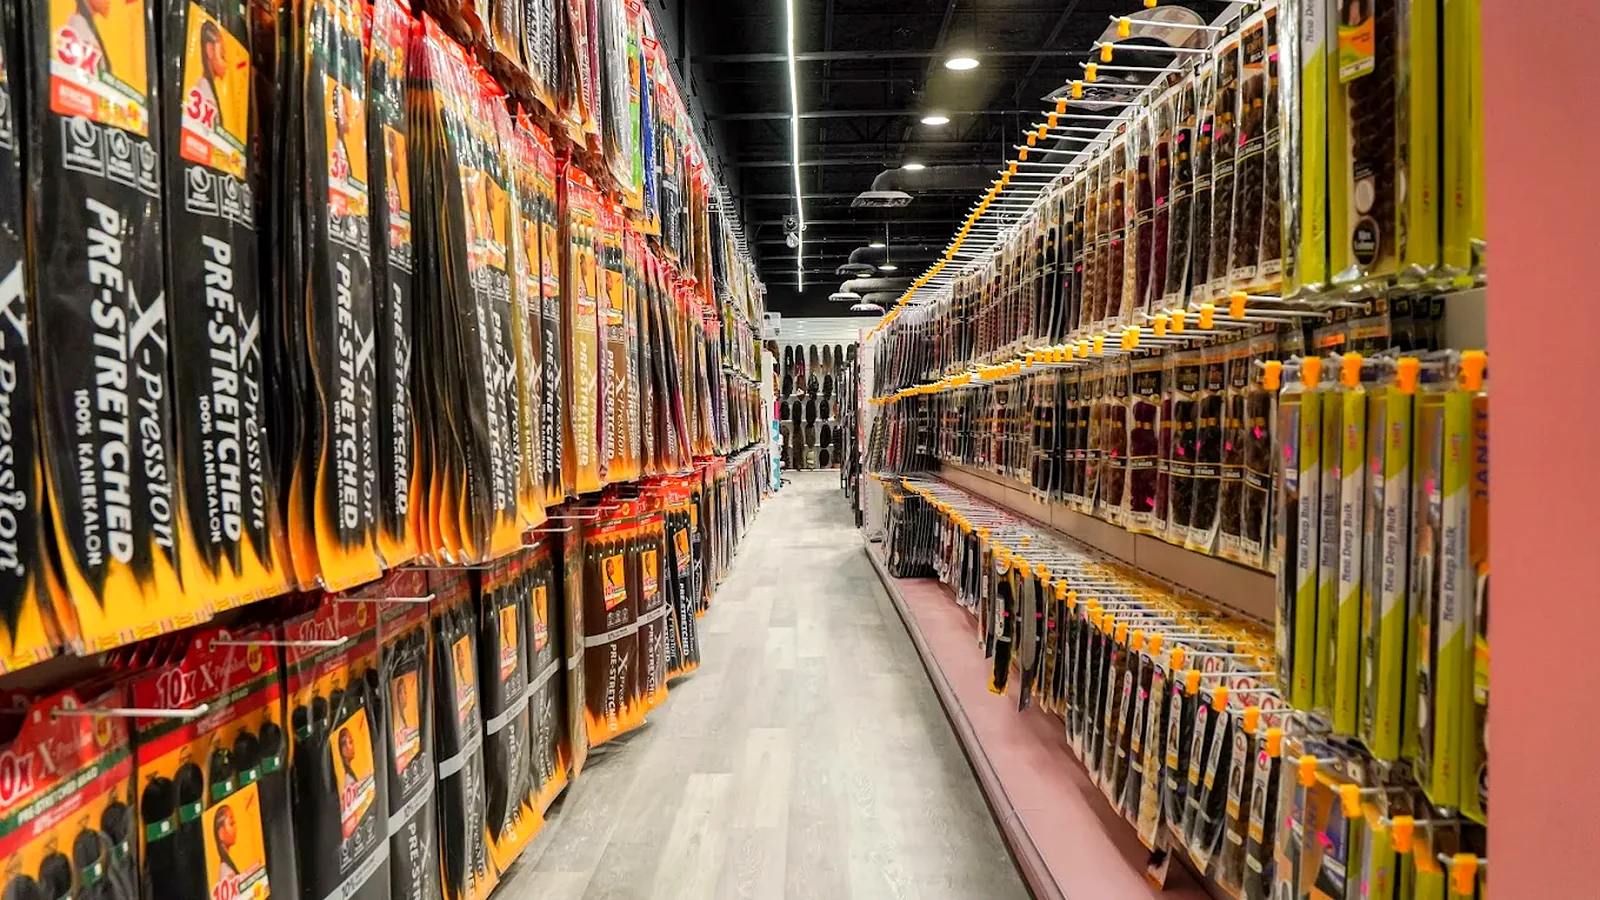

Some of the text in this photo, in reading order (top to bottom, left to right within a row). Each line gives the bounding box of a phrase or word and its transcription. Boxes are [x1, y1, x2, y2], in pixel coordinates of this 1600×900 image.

[74, 389, 102, 566] 100% KANEKALON
[86, 197, 134, 564] PRE-STRETCHED
[128, 279, 175, 548] X-Pression
[199, 395, 222, 543] 100% KANEKALON
[202, 235, 242, 542] PRE-STRETCHED
[237, 302, 265, 529] X-Pression
[336, 261, 358, 529] PRE-STRETCHED
[354, 320, 376, 524] X-Pression
[392, 281, 408, 515] PRE-STRETCHED
[477, 304, 506, 511] PRE-STRETCHED
[545, 329, 553, 473] PRE-STRETCHED
[579, 341, 588, 466] PRE-STRETCHED
[615, 372, 626, 457] X-Pression
[608, 644, 618, 731] PRE-STRETCHED
[679, 583, 689, 656] PRE-STRETCHED
